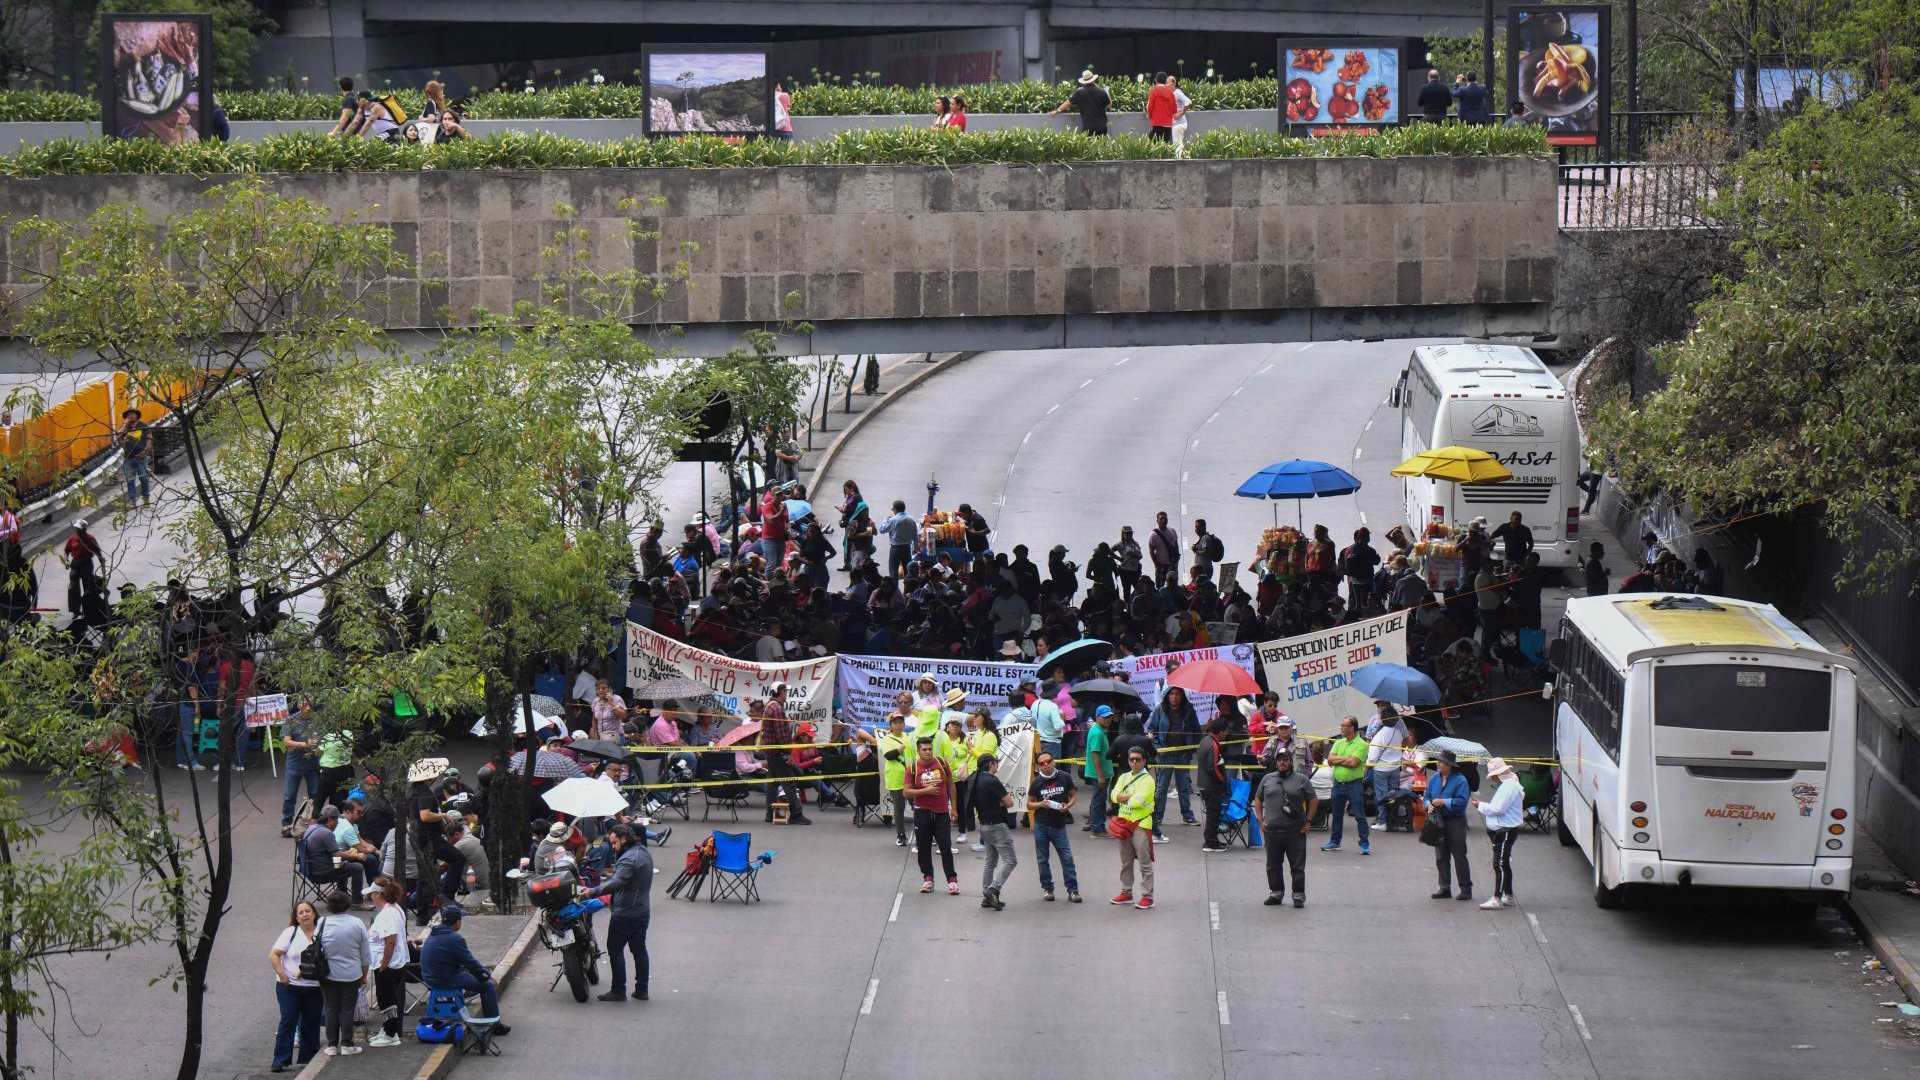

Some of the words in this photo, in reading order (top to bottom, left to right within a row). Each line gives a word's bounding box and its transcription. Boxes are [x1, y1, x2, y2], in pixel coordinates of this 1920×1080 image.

[1262, 638, 1328, 664] ABROGACION
[1329, 634, 1344, 650] DE
[1346, 629, 1361, 646] LA
[1362, 622, 1384, 643] LEY
[1385, 616, 1405, 634] DEL
[888, 661, 900, 672] EL
[902, 662, 931, 673] PARO!
[936, 664, 949, 675] ES
[951, 665, 983, 677] CULPA
[985, 667, 1003, 678] DEL
[1294, 655, 1338, 678] ISSSTE
[1347, 643, 1377, 665] 2007
[1287, 671, 1348, 702] JUBILACION
[1704, 808, 1777, 821] NAUCALPAN
